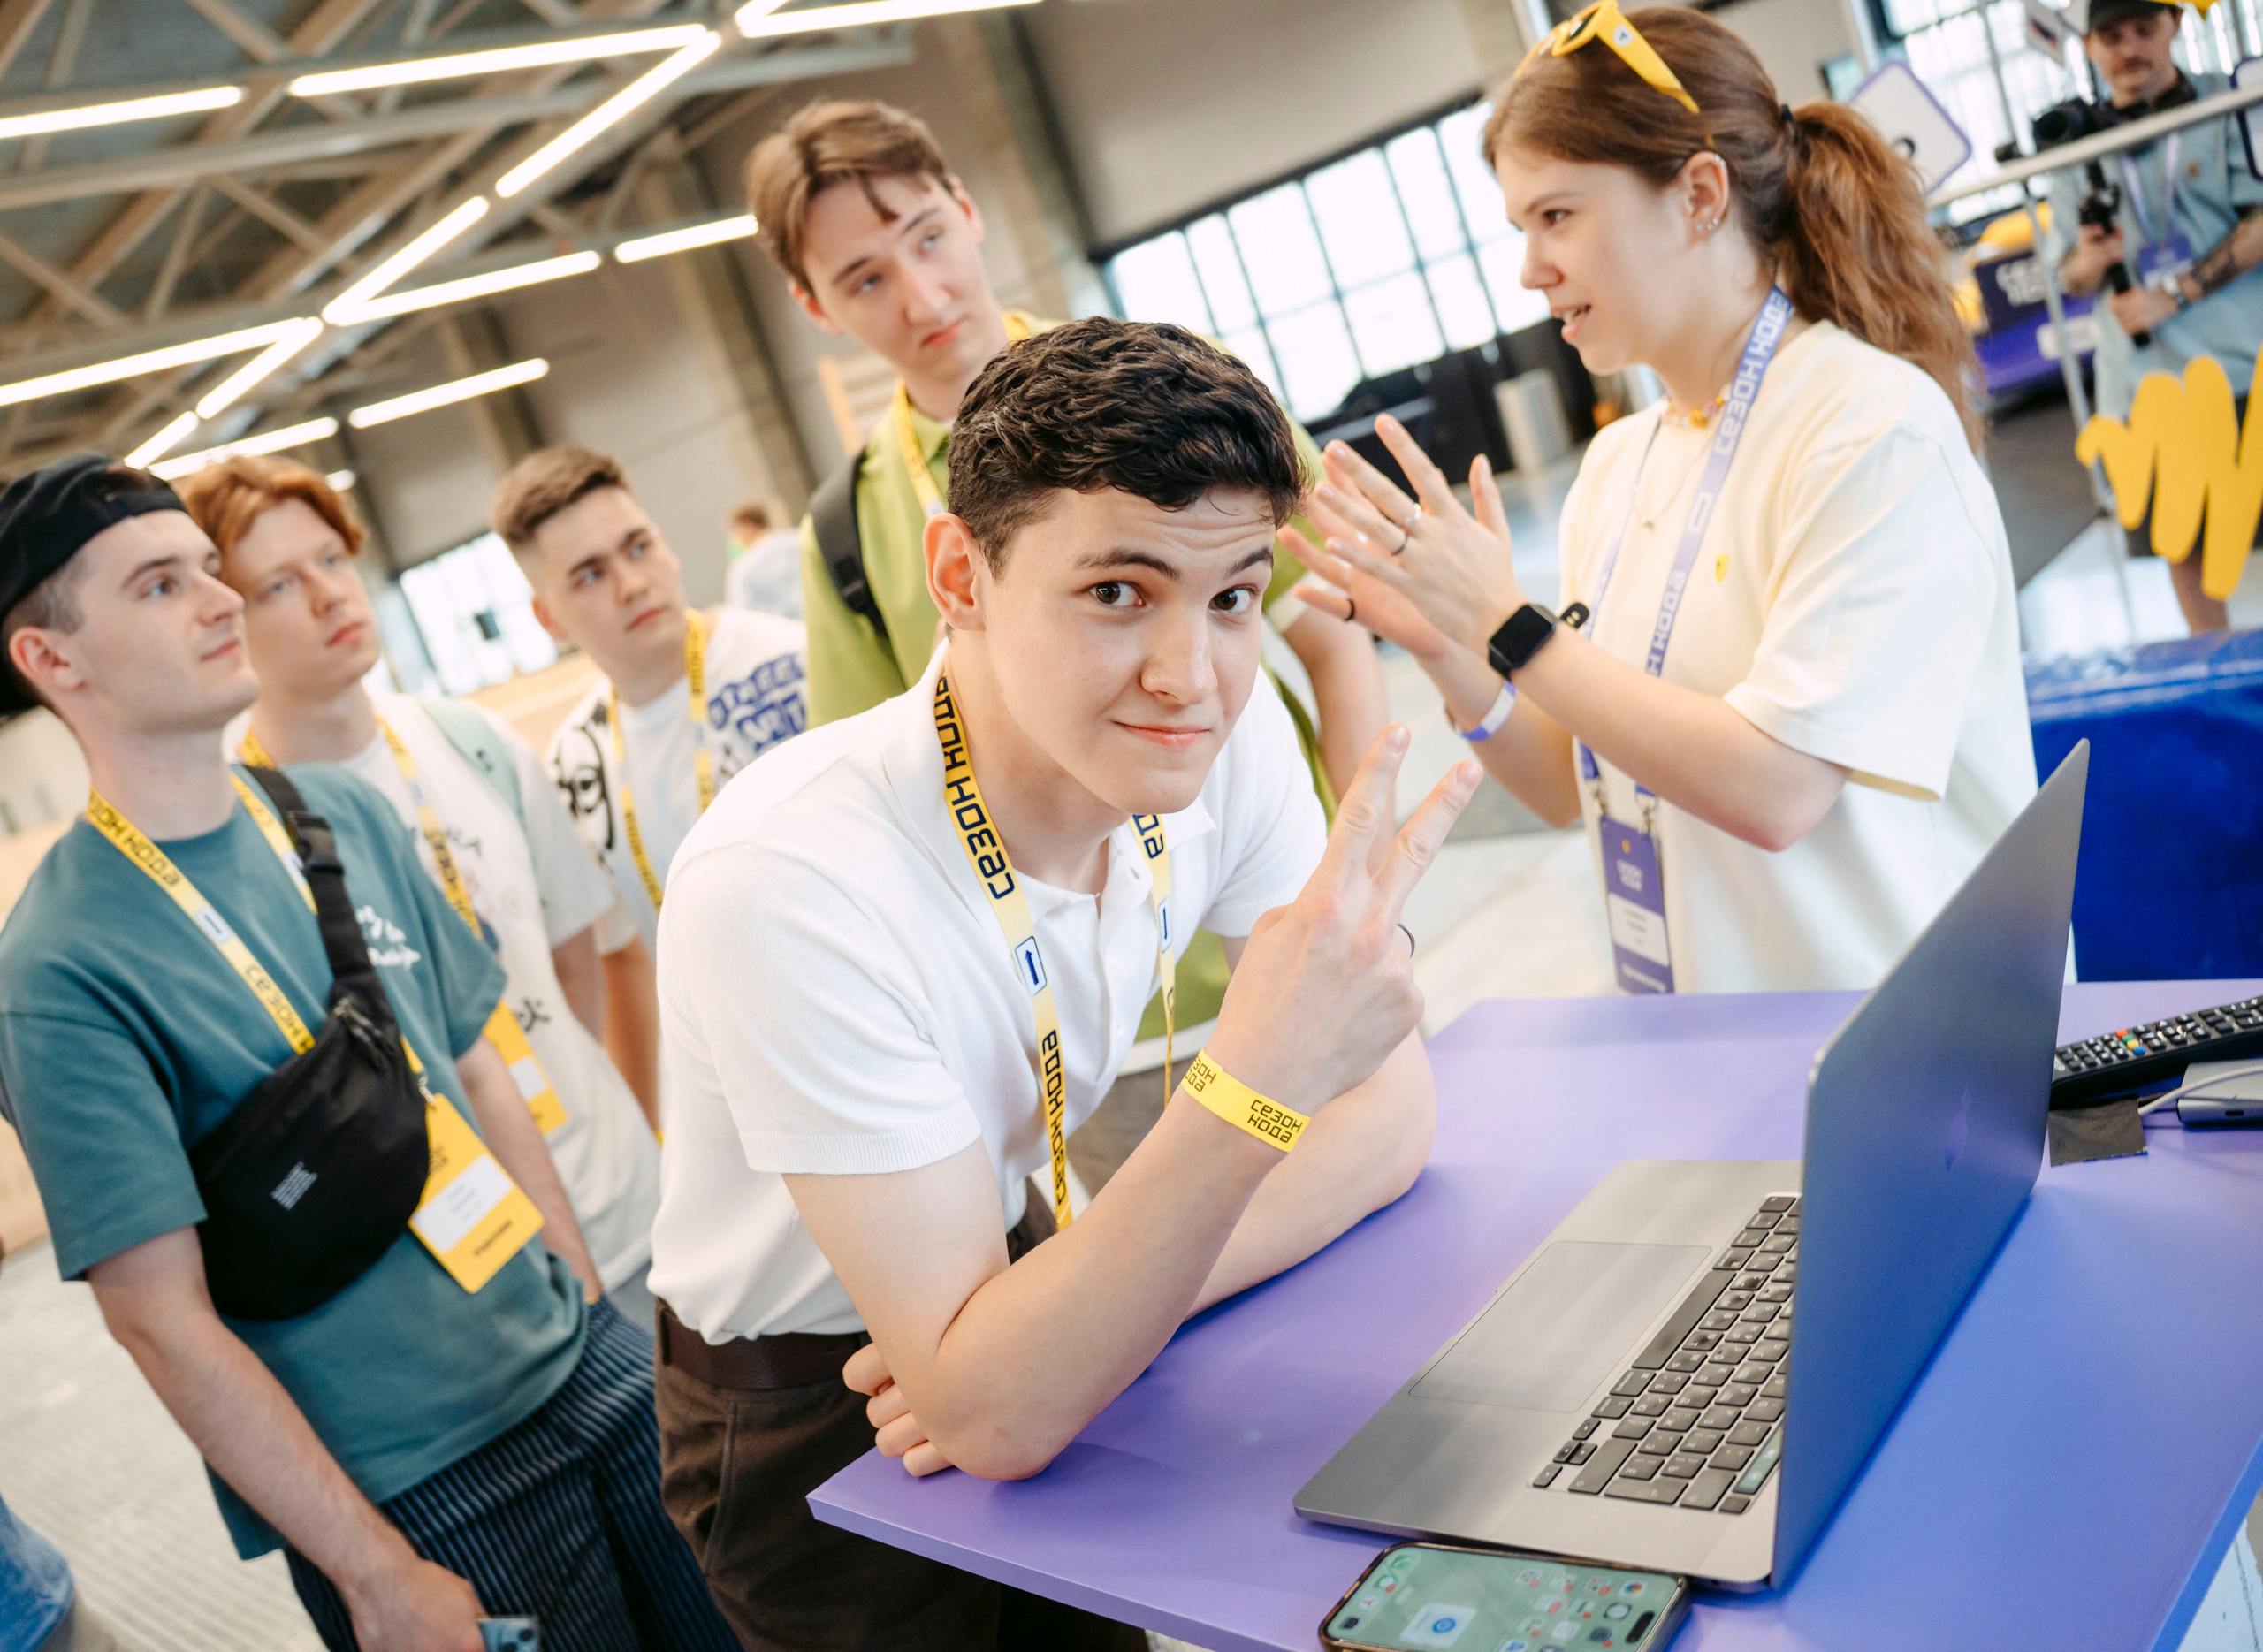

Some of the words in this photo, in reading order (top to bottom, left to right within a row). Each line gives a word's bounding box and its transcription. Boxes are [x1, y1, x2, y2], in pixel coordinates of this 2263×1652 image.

[1713, 358, 1764, 455] сезон
[946, 775, 1015, 900] сезон
[1133, 814, 1164, 859] да
[1041, 1029, 1064, 1116] кода
[1185, 1068, 1206, 1092] ода
[1192, 1056, 1216, 1085] зон
[1247, 1113, 1292, 1143] кода
[1250, 1100, 1303, 1133] сезон
